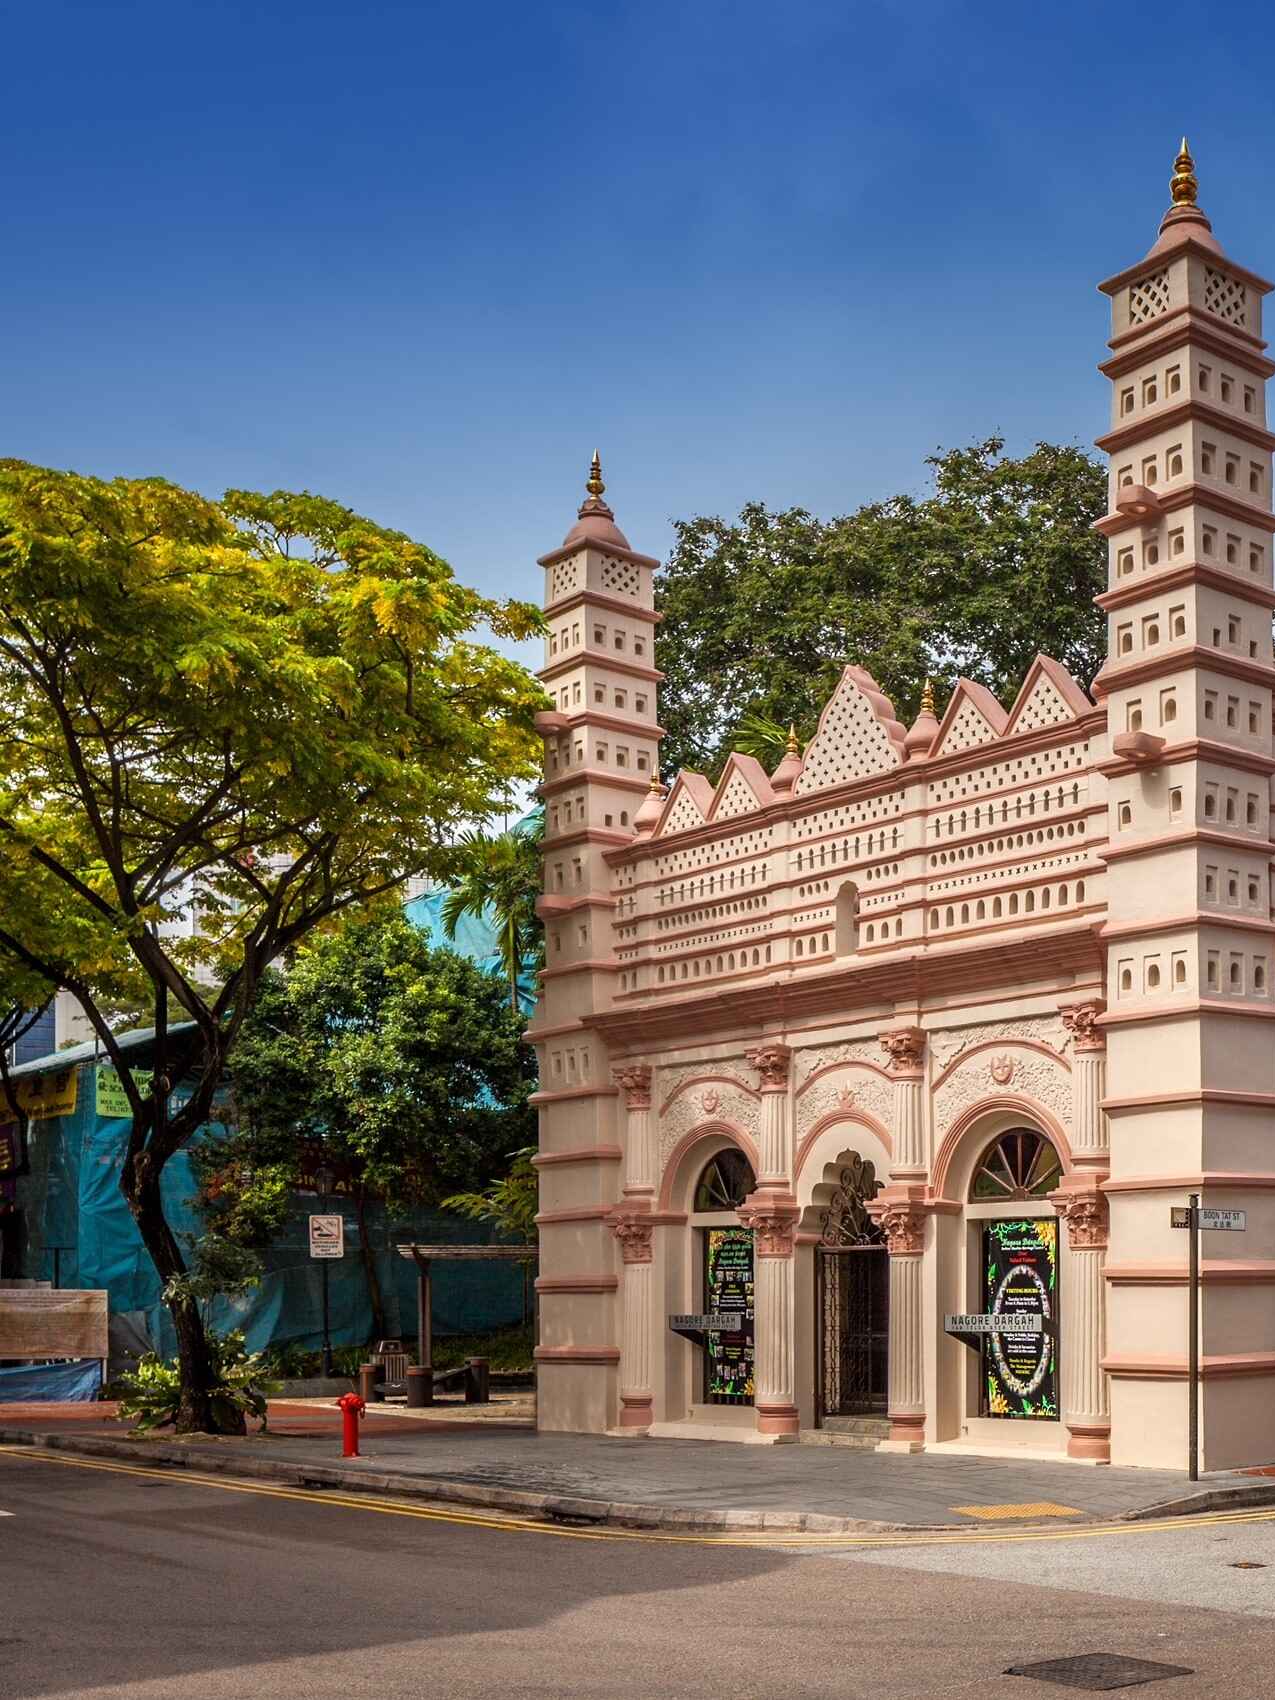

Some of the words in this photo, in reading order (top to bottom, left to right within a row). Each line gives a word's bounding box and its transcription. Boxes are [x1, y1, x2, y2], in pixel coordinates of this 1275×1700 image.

[1221, 1212, 1231, 1220] TAT
[705, 1315, 736, 1324] DARGAH
[951, 1315, 990, 1325] NAGORE
[994, 1315, 1034, 1325] DARGAH
